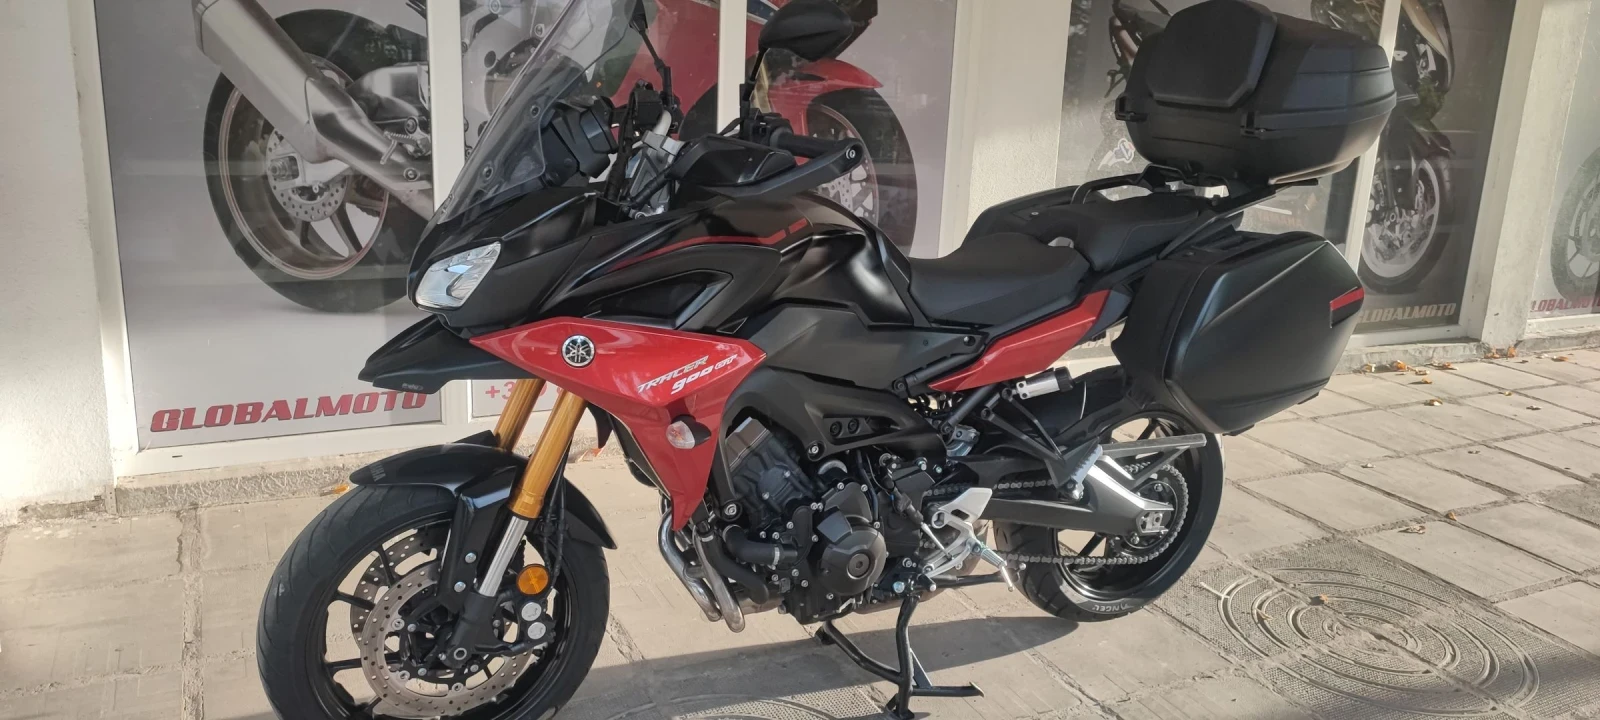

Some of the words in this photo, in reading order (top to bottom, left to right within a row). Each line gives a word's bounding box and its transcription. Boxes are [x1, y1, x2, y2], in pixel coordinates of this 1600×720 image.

[637, 355, 709, 394] TRACER
[671, 365, 714, 395] 900
[150, 390, 427, 432] GLOBALMOTO
